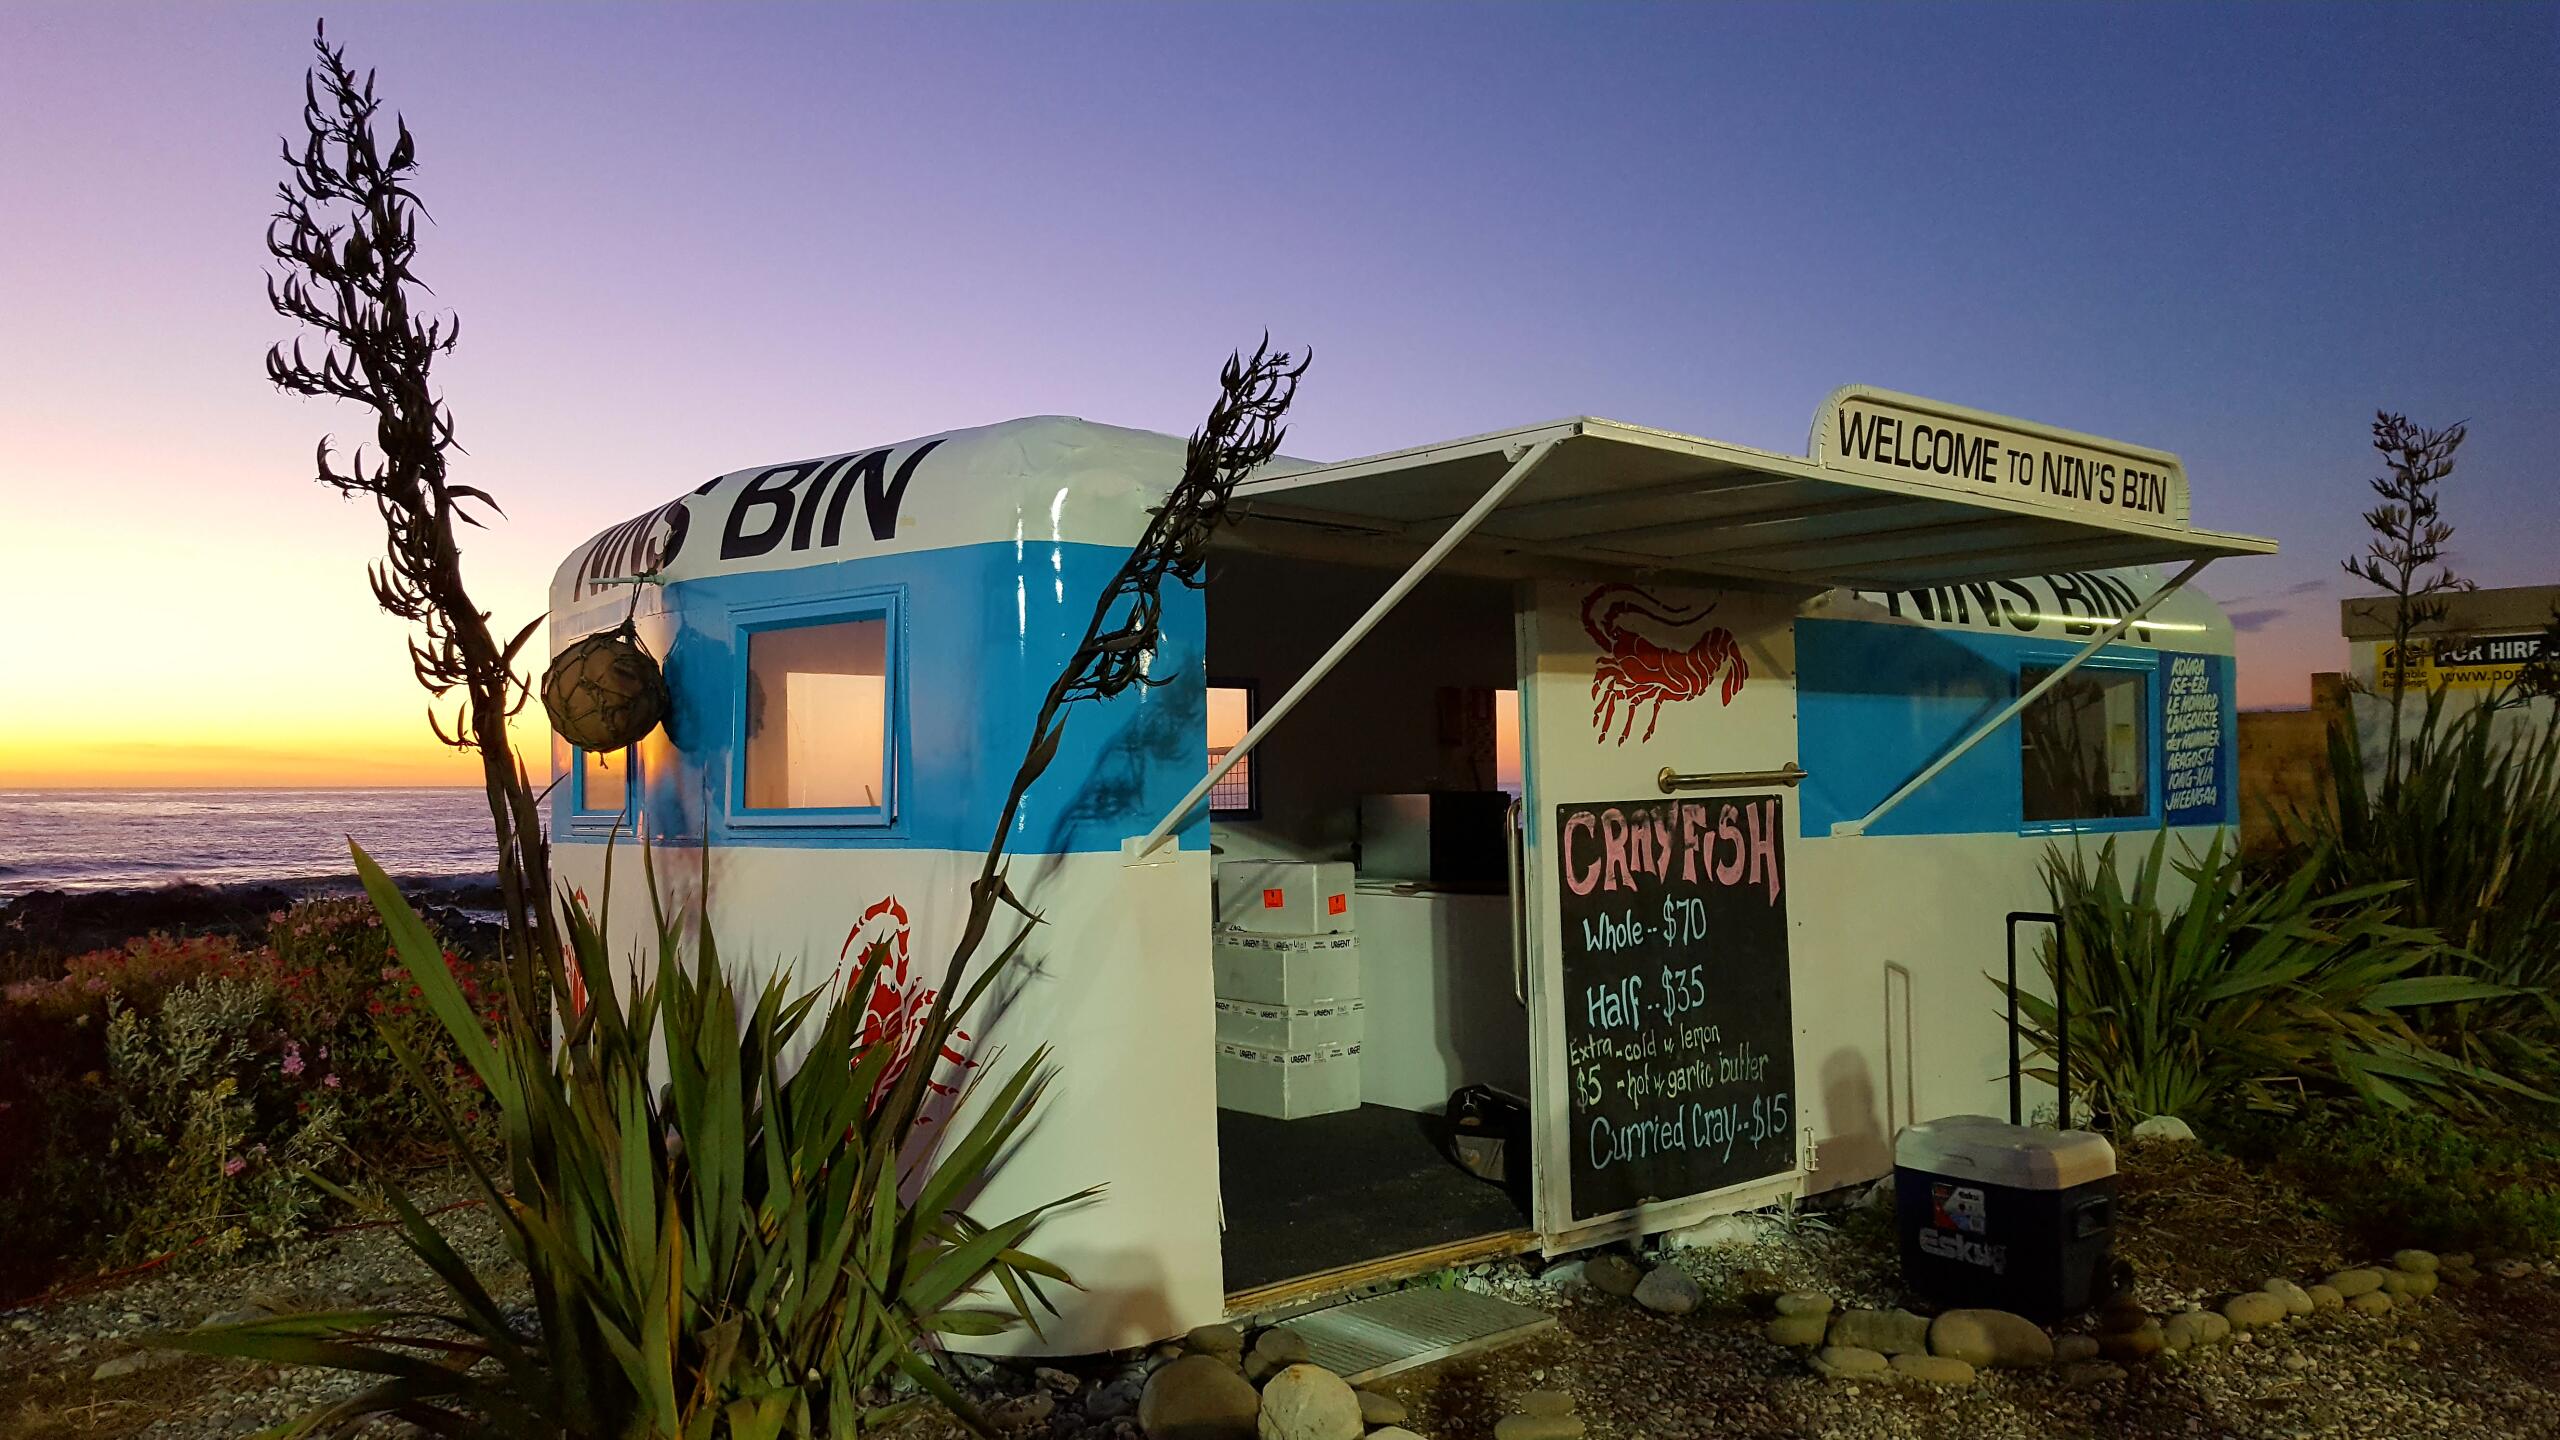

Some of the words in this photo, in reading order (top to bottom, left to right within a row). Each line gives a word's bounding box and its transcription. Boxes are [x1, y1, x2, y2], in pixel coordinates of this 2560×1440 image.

[1839, 408, 2000, 483] WELCOME
[2041, 451, 2115, 504] NIN'S
[2122, 468, 2166, 514] BIN
[720, 438, 948, 561] BIN
[2167, 696, 2180, 714] LE
[2167, 711, 2218, 734] LANGOUSTE
[1663, 894, 1707, 948] $70
[1330, 940, 1350, 949] URGENT
[1662, 964, 1705, 1026] $35
[1314, 1008, 1334, 1017] URGENT
[1348, 1044, 1360, 1056] URGE
[1680, 1022, 1721, 1054] lemon
[1290, 1054, 1311, 1064] URGENT
[1576, 1064, 1602, 1114] $5
[1667, 1059, 1714, 1098] garlic
[1719, 1042, 1769, 1084] butter
[1590, 1104, 1686, 1170] Curried
[1750, 1092, 1788, 1150] $15
